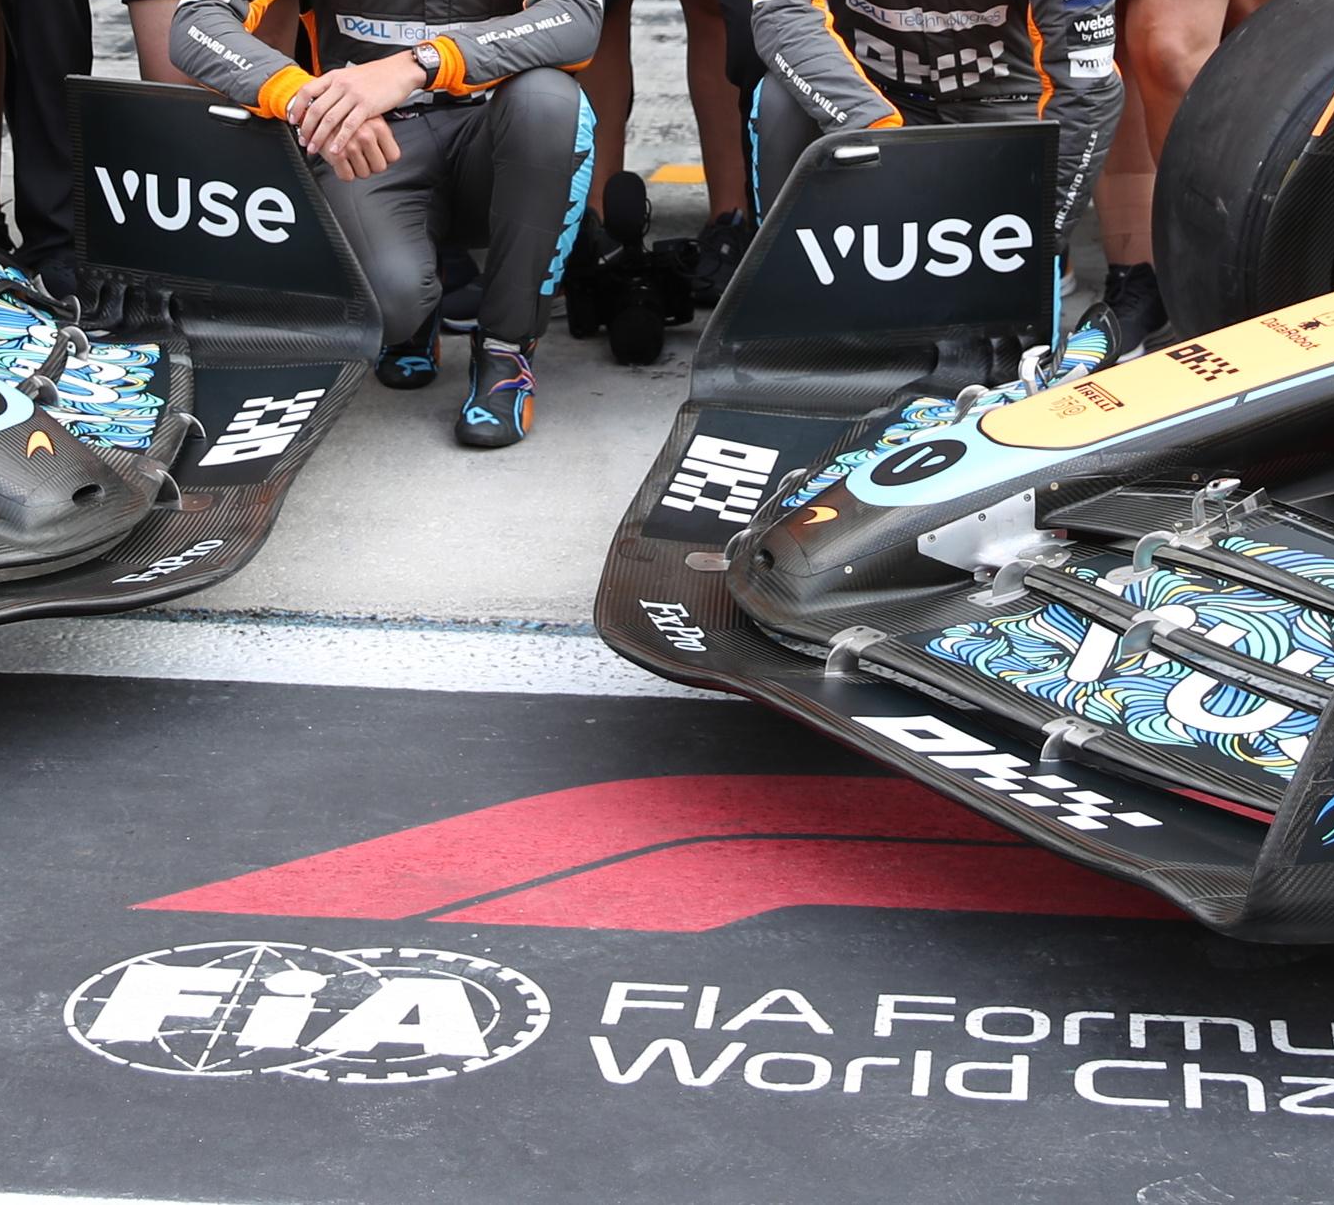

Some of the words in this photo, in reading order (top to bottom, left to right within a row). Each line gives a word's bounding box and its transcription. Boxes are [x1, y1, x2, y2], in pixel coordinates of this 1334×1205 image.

[343, 16, 392, 39] DELL
[535, 12, 572, 31] MILLE
[812, 89, 848, 125] MILLE
[1259, 317, 1322, 351] DataRobot
[1166, 343, 1240, 382] OKX
[1073, 381, 1125, 413] PIRELLI
[112, 537, 224, 585] FxPro
[639, 598, 709, 652] FxPro
[599, 981, 835, 1036] FIA
[588, 1035, 1031, 1101] World
